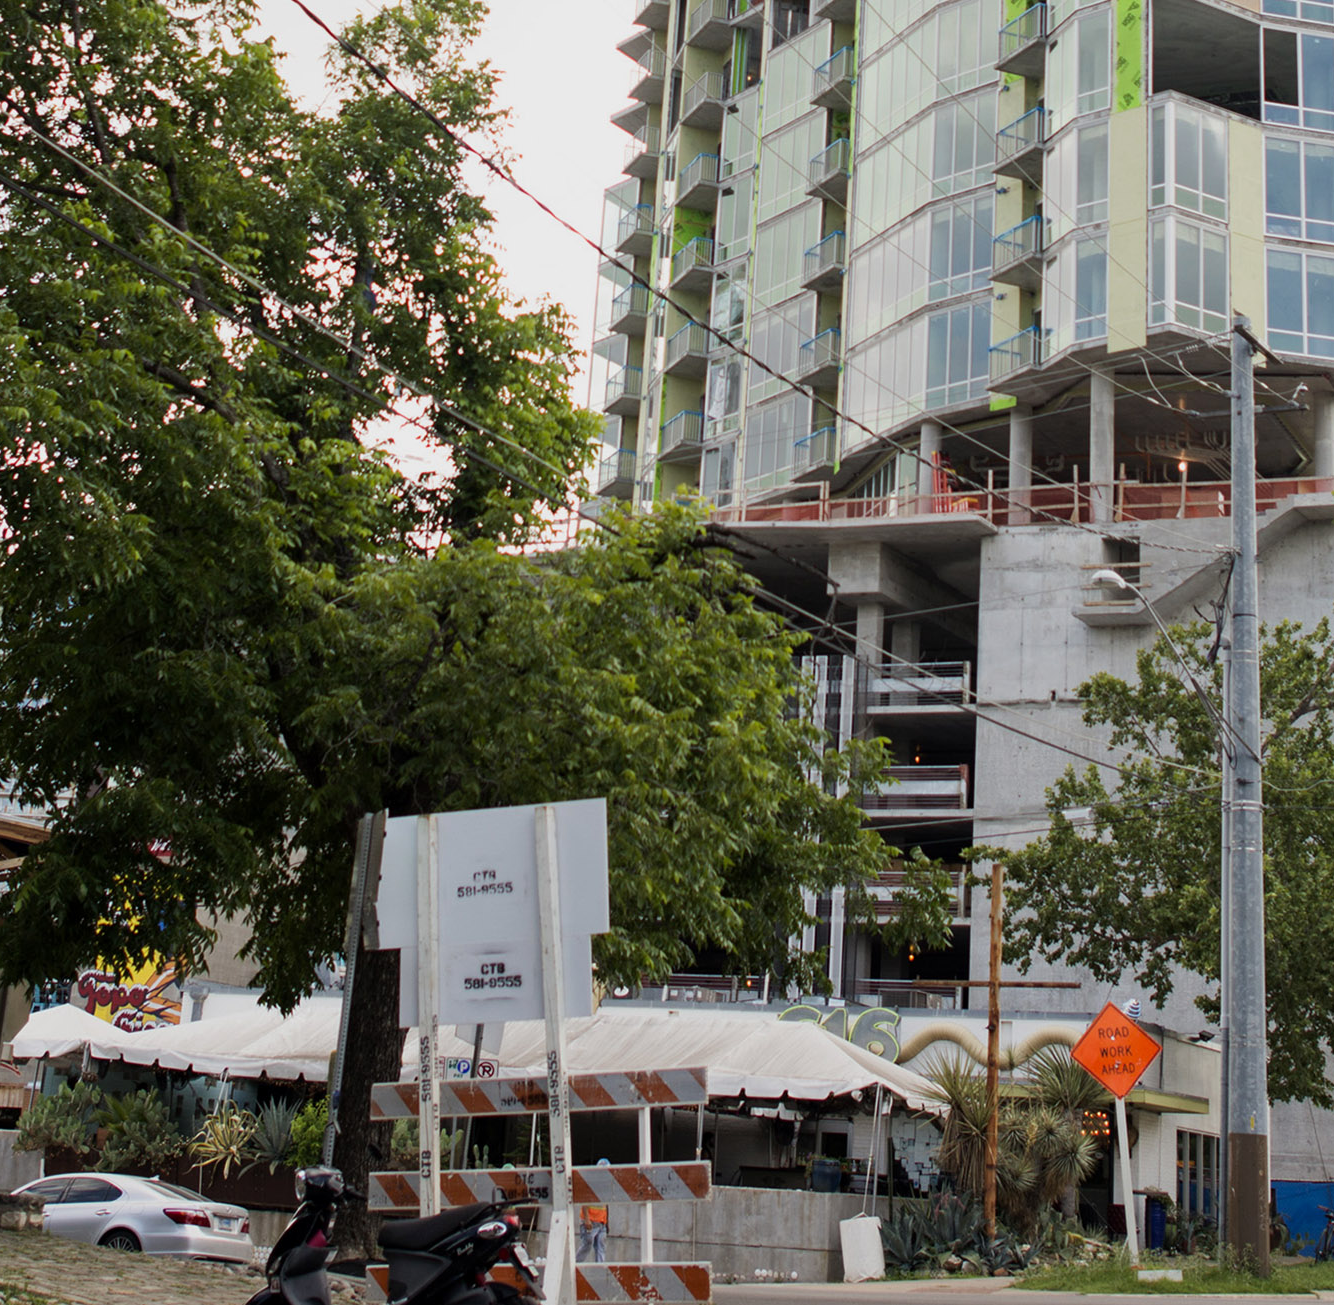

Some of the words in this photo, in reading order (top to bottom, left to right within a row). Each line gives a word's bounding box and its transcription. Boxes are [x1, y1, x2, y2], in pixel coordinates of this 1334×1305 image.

[457, 881, 514, 898] 581-9555
[480, 961, 506, 976] CTB
[464, 974, 523, 990] 581-9555
[1097, 1026, 1130, 1039] ROAD
[1099, 1045, 1133, 1059] WORK
[1101, 1062, 1136, 1076] AHEAD
[421, 1148, 432, 1180] CTB
[553, 1145, 566, 1174] CTB
